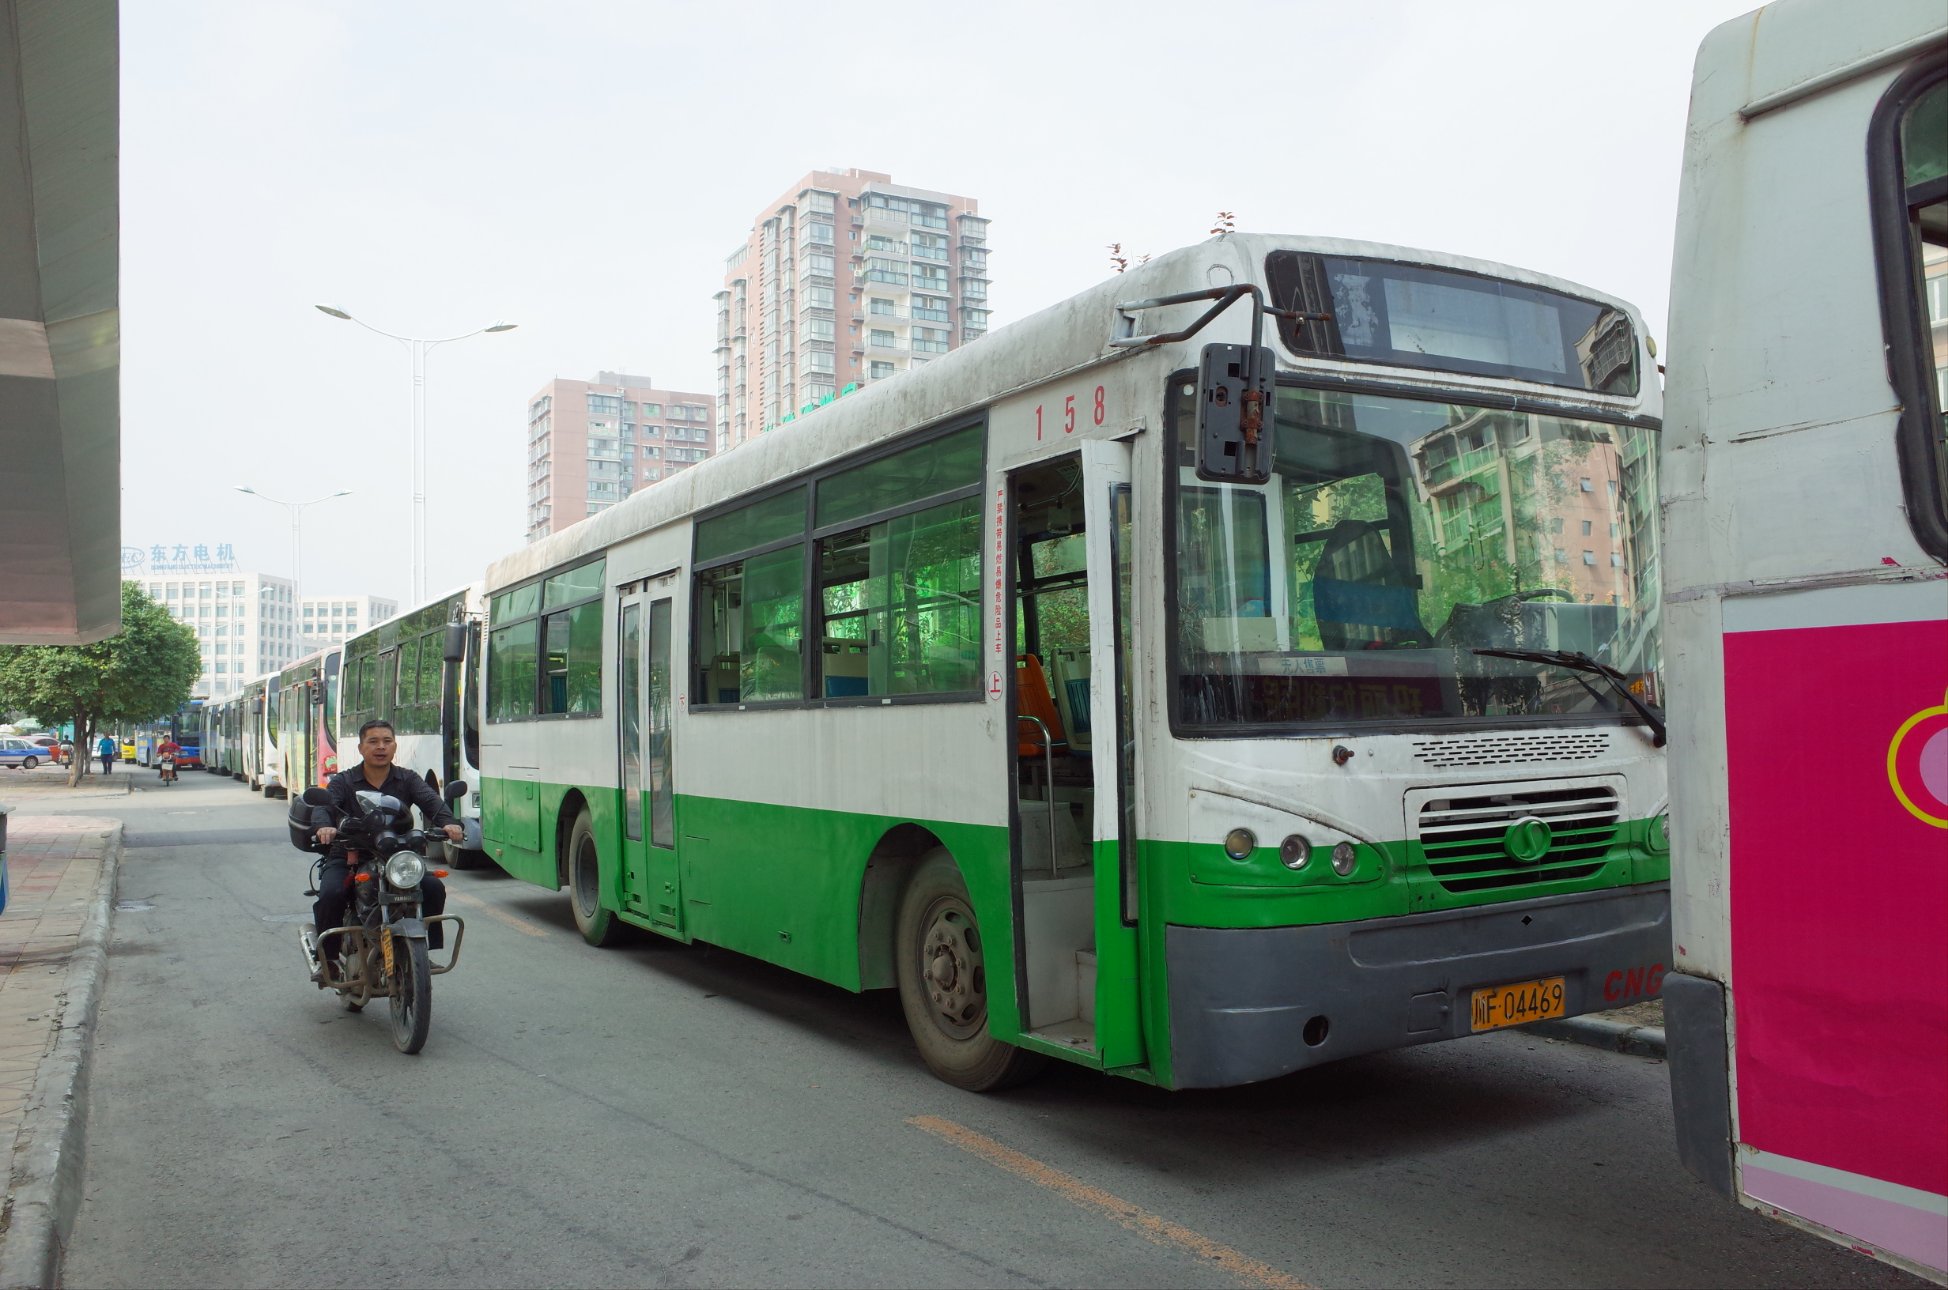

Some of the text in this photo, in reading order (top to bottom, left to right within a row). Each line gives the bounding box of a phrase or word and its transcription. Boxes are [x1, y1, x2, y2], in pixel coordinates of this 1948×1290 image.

[1036, 386, 1104, 440] 158
[150, 543, 234, 560] 东方电机
[1281, 658, 1326, 673] 无人售票
[990, 673, 1001, 692] 上
[1603, 963, 1665, 1001] CNG
